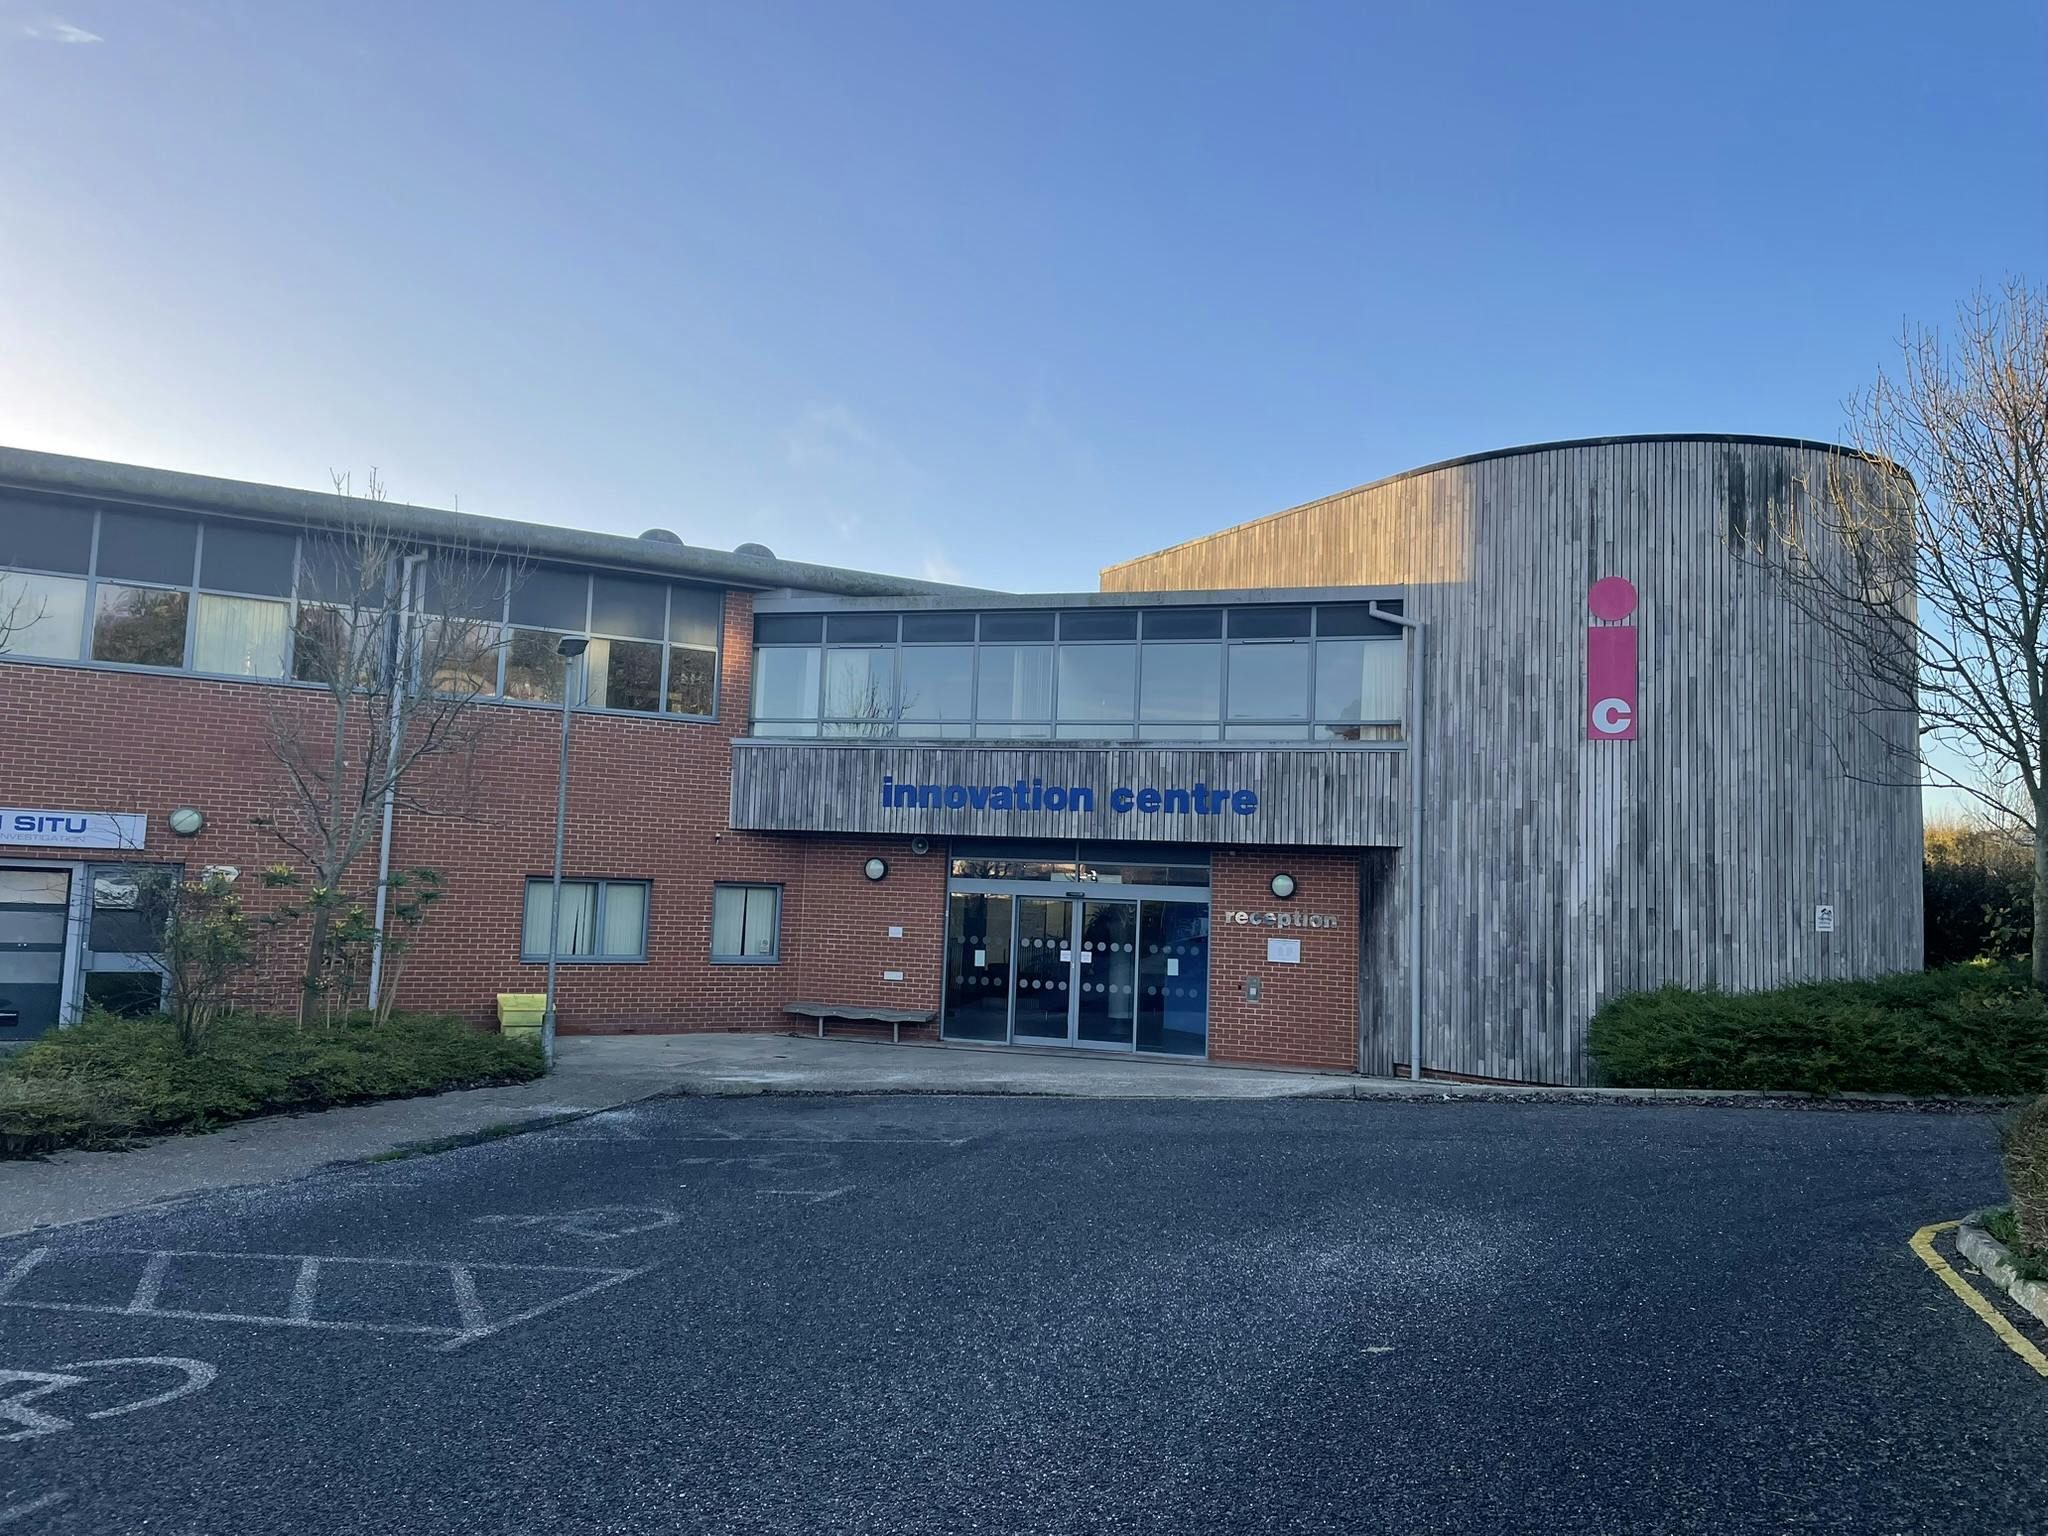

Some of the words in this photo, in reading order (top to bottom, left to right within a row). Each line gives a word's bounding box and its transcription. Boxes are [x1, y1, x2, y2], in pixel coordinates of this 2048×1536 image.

[883, 776, 1094, 812] innovation
[1110, 783, 1258, 815] centre
[14, 816, 87, 833] SITU
[1225, 910, 1339, 929] reception
